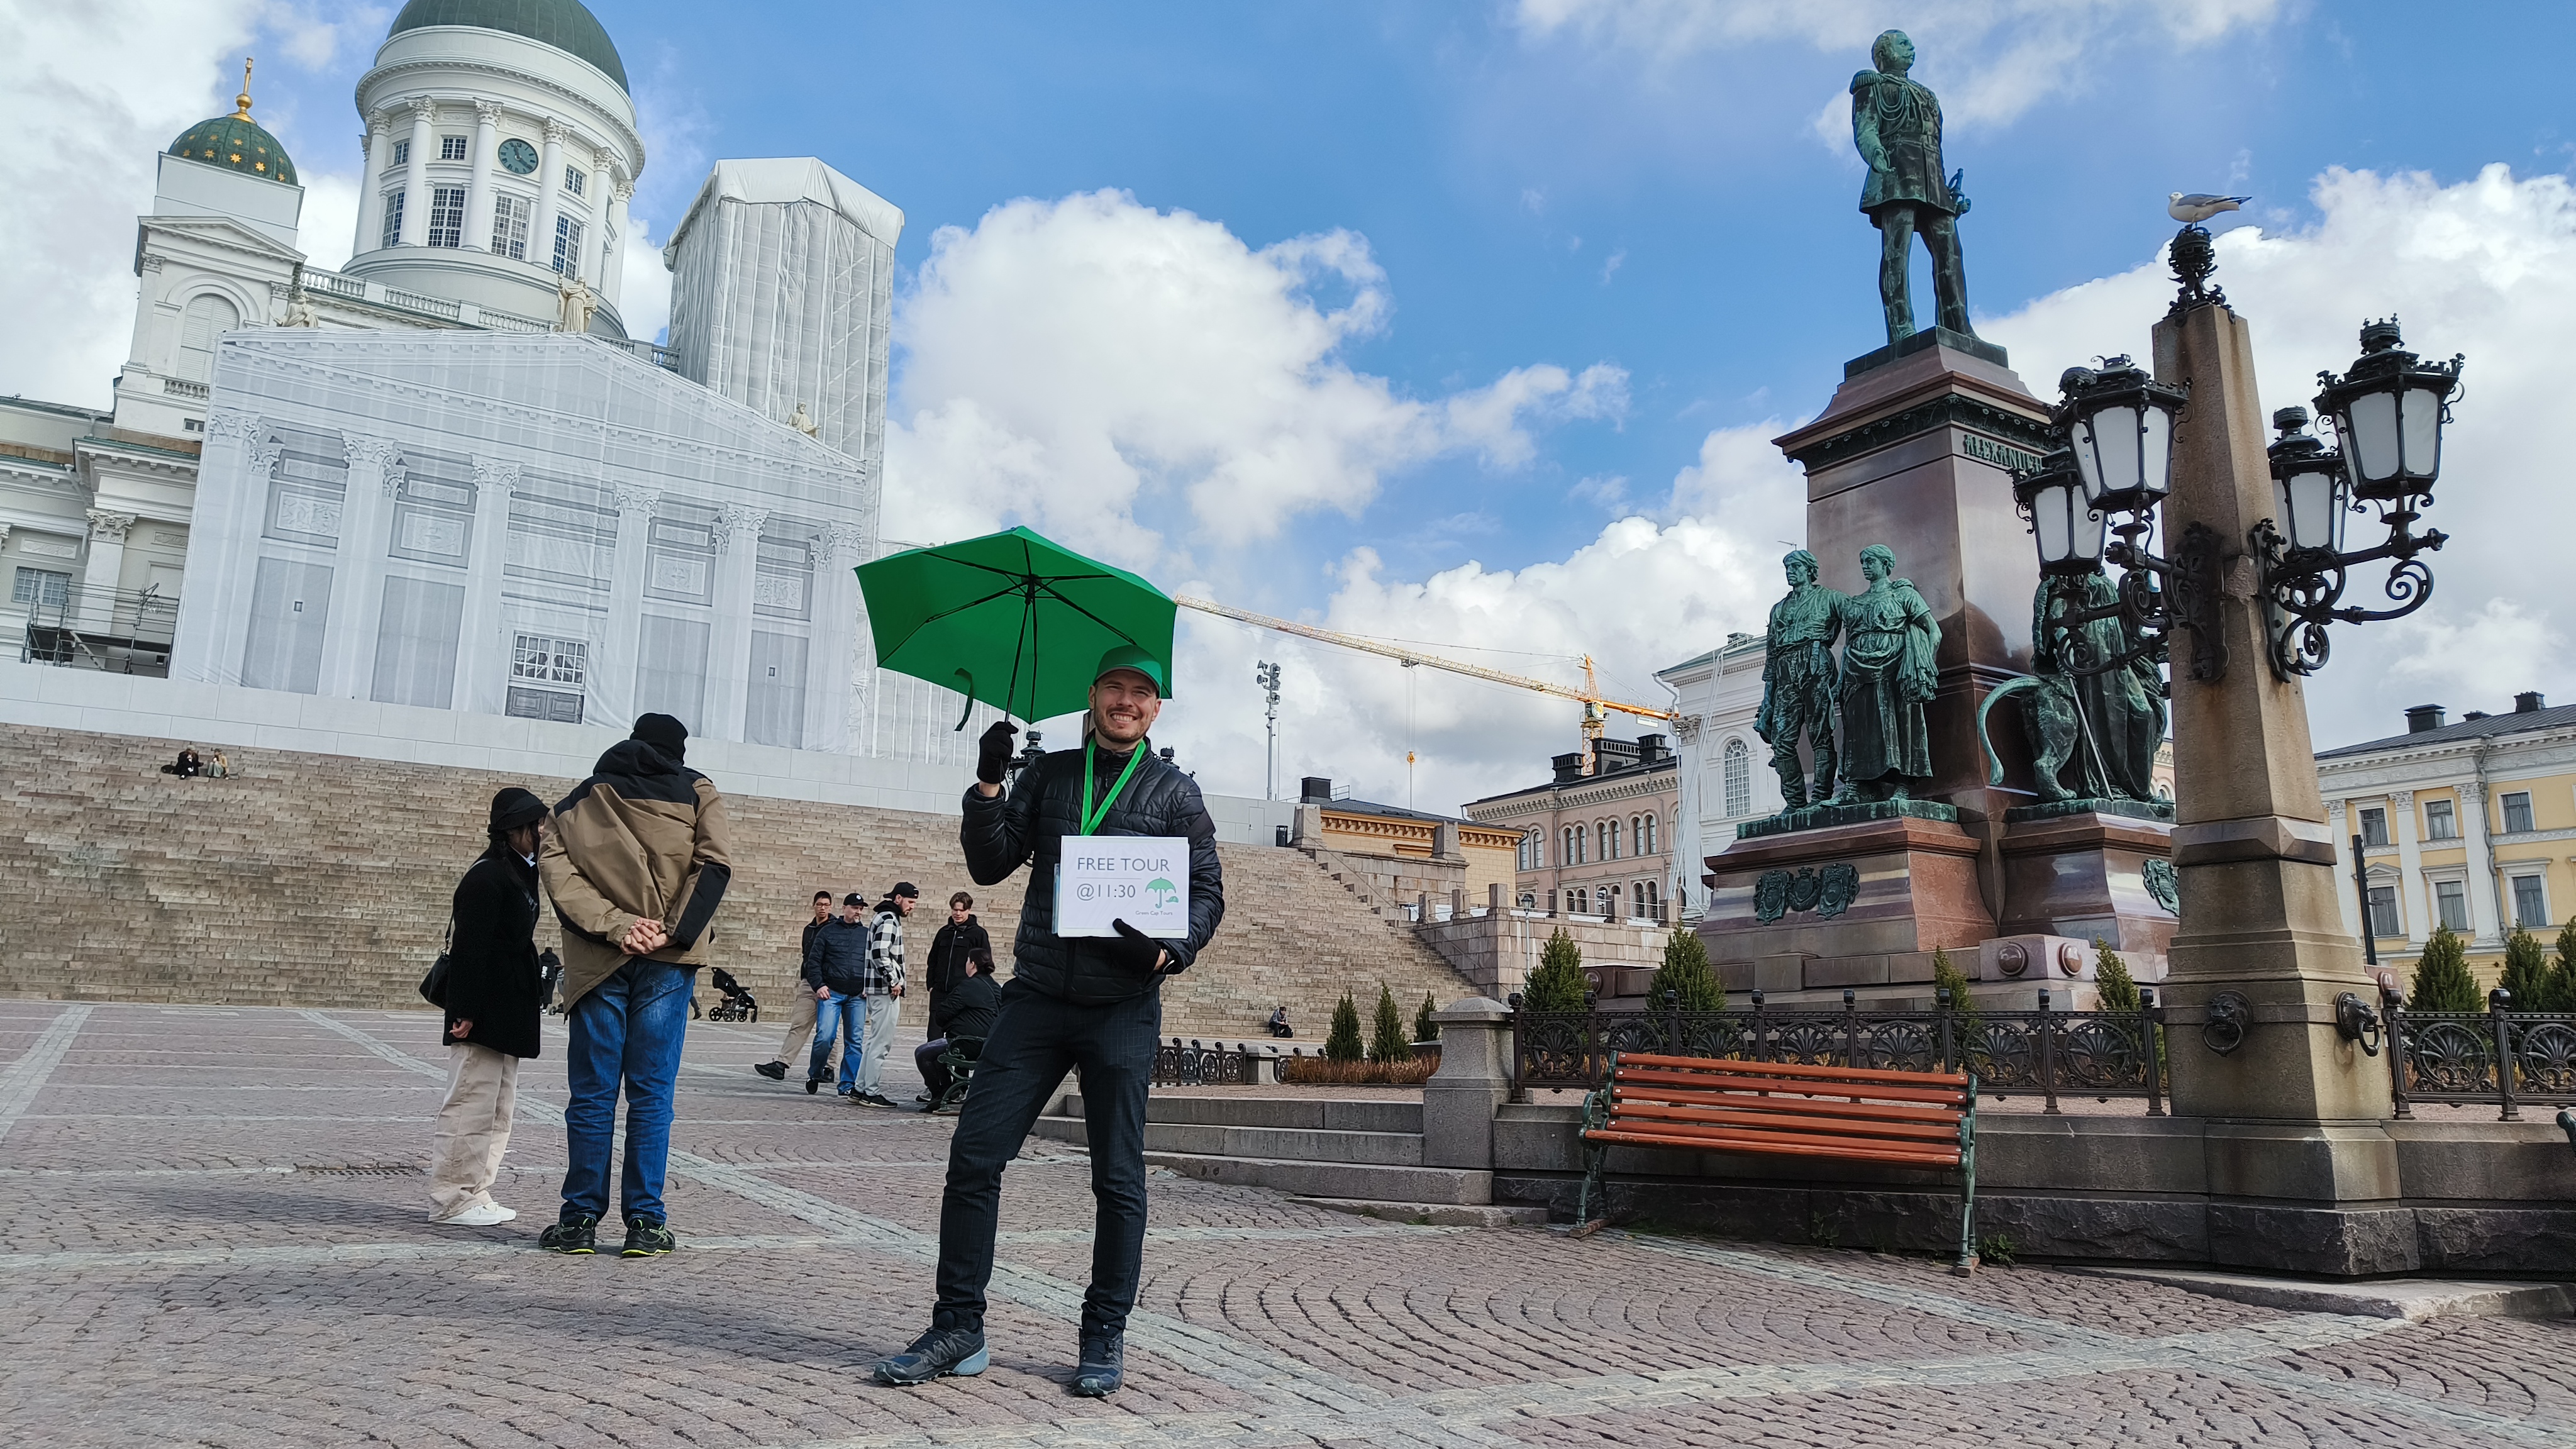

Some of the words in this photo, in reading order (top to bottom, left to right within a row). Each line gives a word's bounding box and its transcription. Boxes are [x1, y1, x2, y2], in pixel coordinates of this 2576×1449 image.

[1077, 857, 1115, 871] FREE
[1120, 858, 1170, 872] TOUR
[1077, 883, 1136, 901] @11:30
